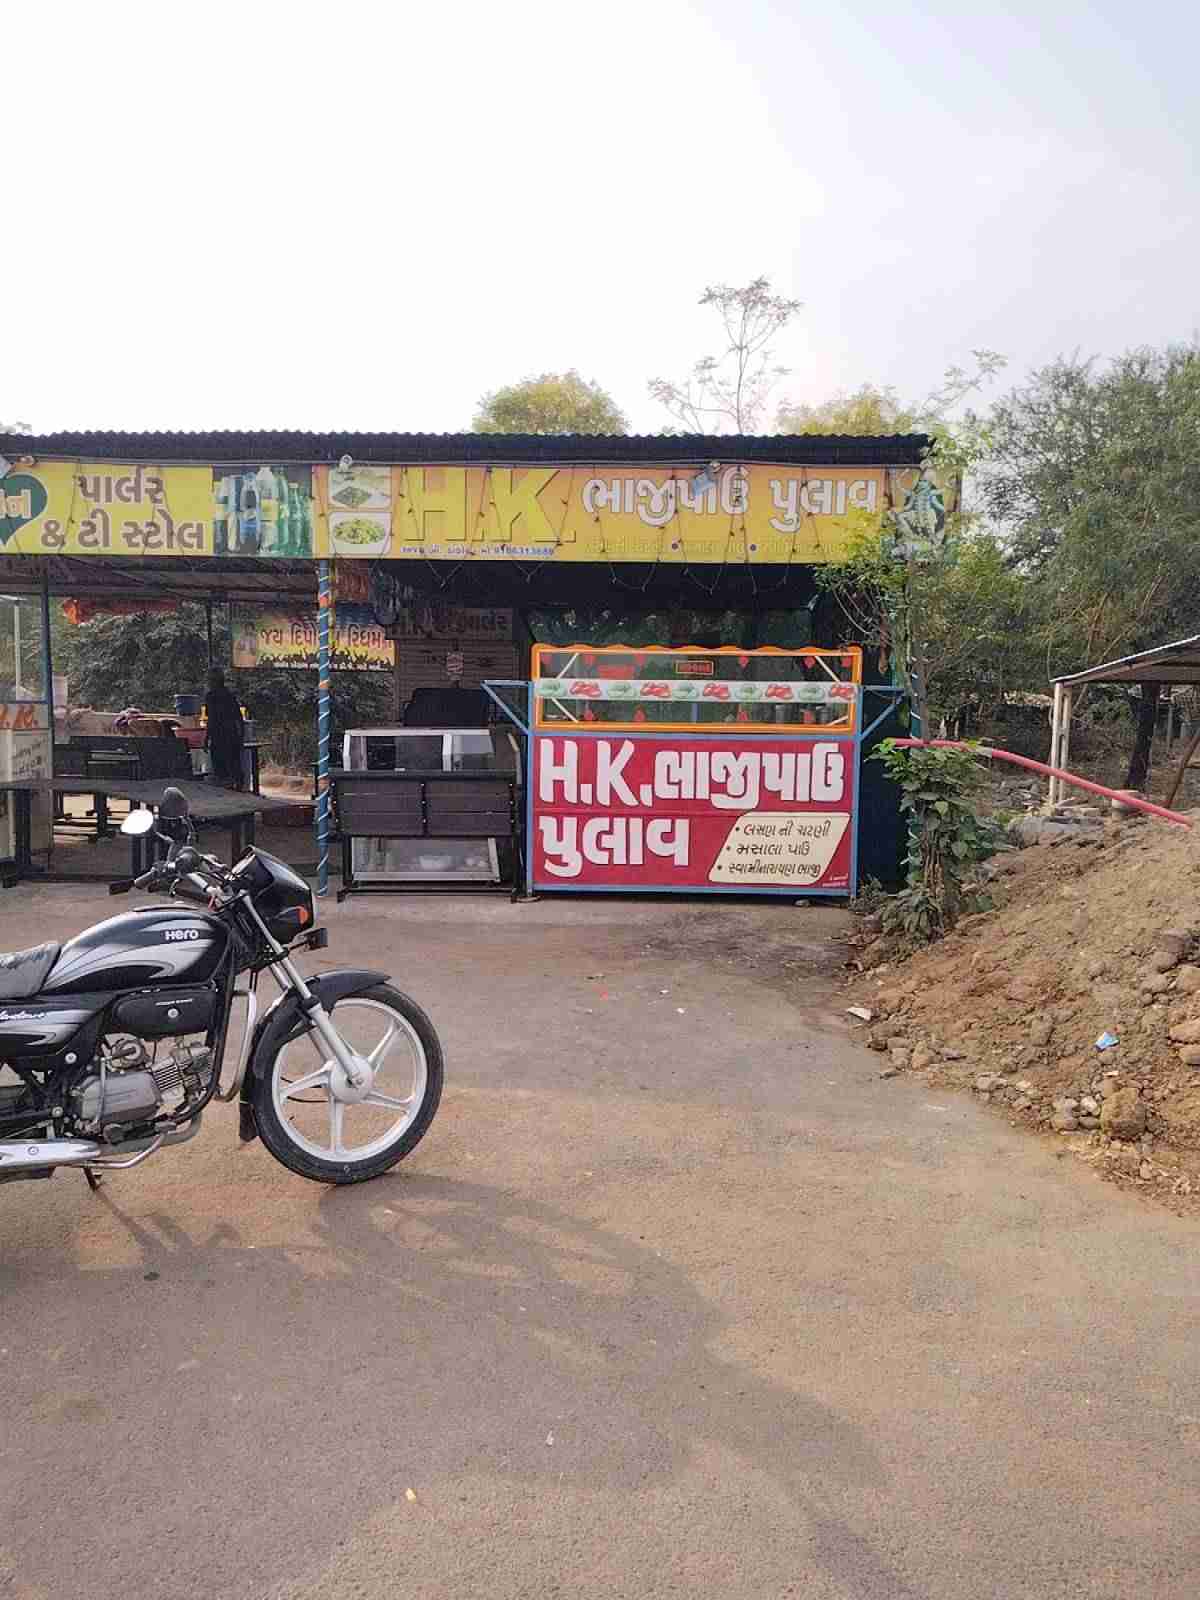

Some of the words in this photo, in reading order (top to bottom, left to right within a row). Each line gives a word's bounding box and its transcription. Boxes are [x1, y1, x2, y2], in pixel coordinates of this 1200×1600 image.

[79, 465, 164, 503] પાર્લર
[582, 464, 749, 527] ભાજીપાઉ
[769, 478, 877, 532] પુલાવ
[41, 520, 66, 547] &
[78, 508, 110, 547] ટી
[122, 508, 204, 549] સ્ટોલ
[260, 627, 282, 645] જય
[539, 816, 690, 878] પુલાવ
[165, 929, 199, 940] Hero
